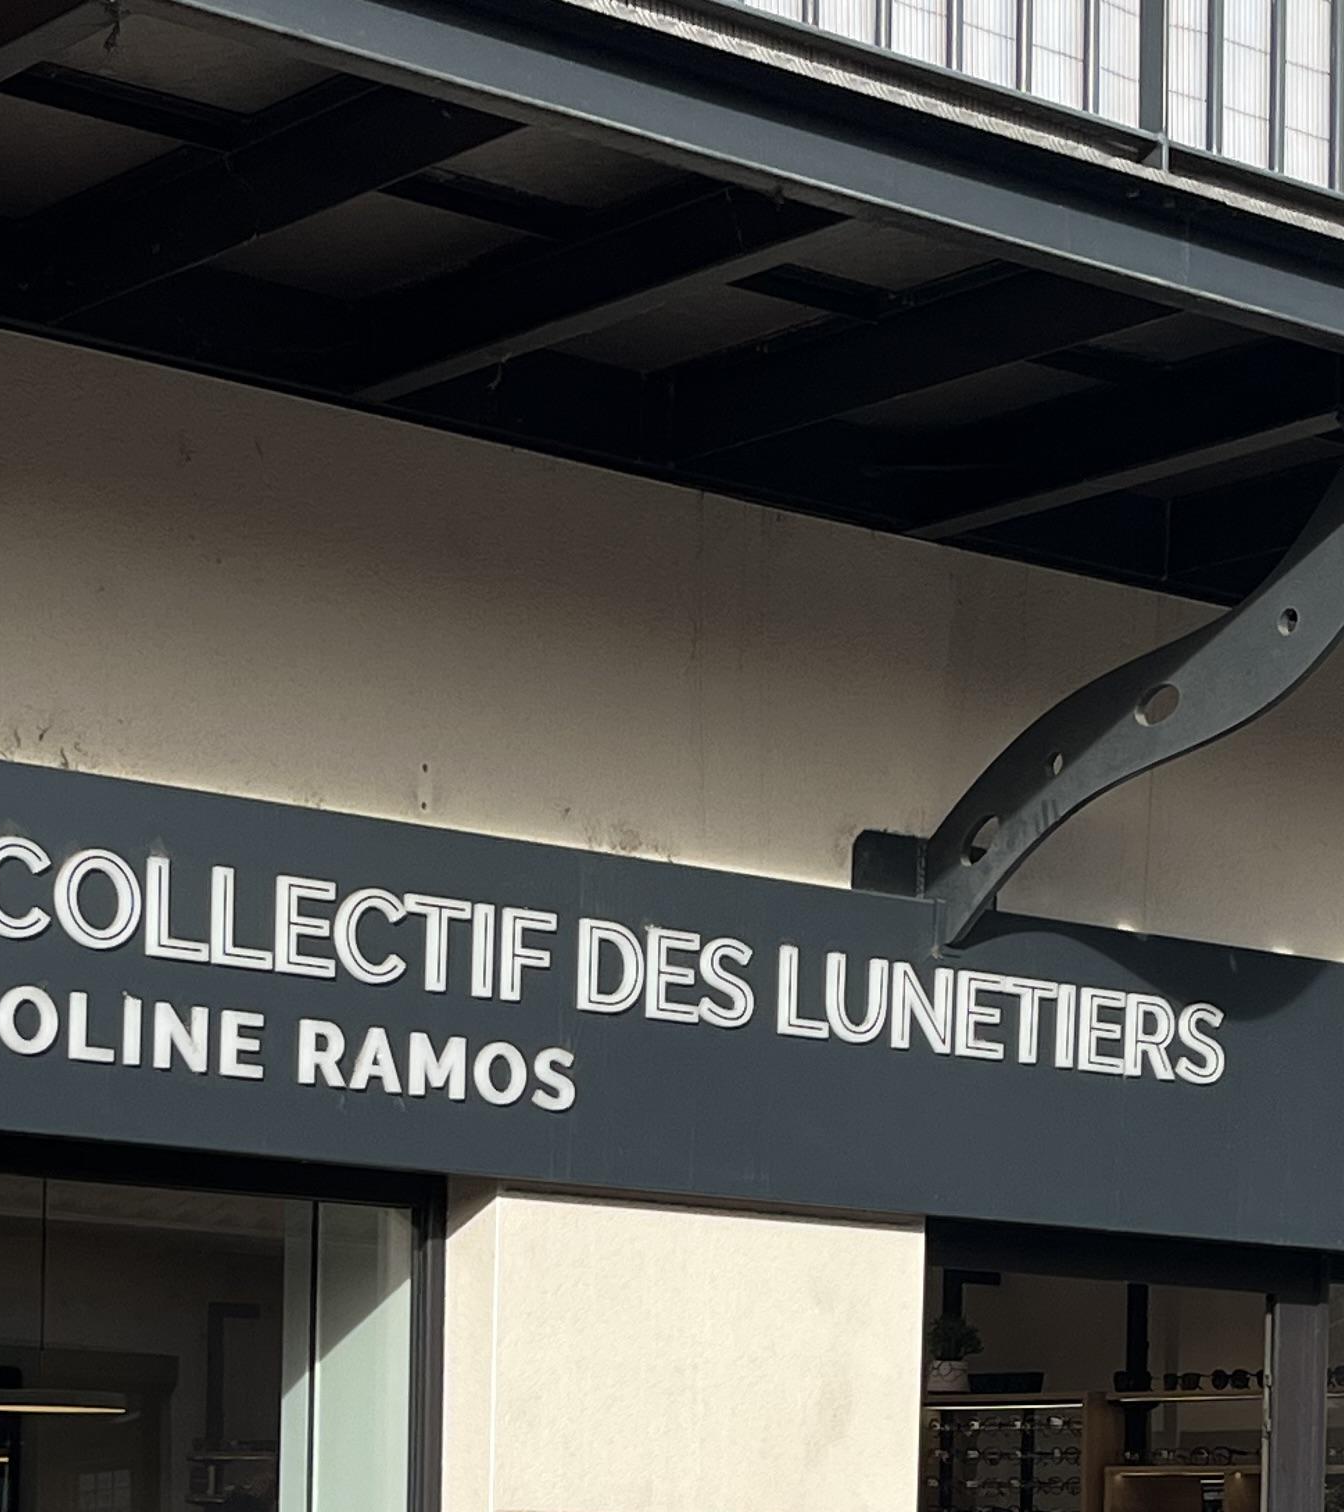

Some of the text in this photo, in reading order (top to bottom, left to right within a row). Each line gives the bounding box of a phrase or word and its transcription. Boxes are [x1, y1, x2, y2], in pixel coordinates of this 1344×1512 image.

[297, 1018, 576, 1111] RAMOS
[577, 917, 755, 1028] DES
[778, 945, 1225, 1085] LUNETIERS
